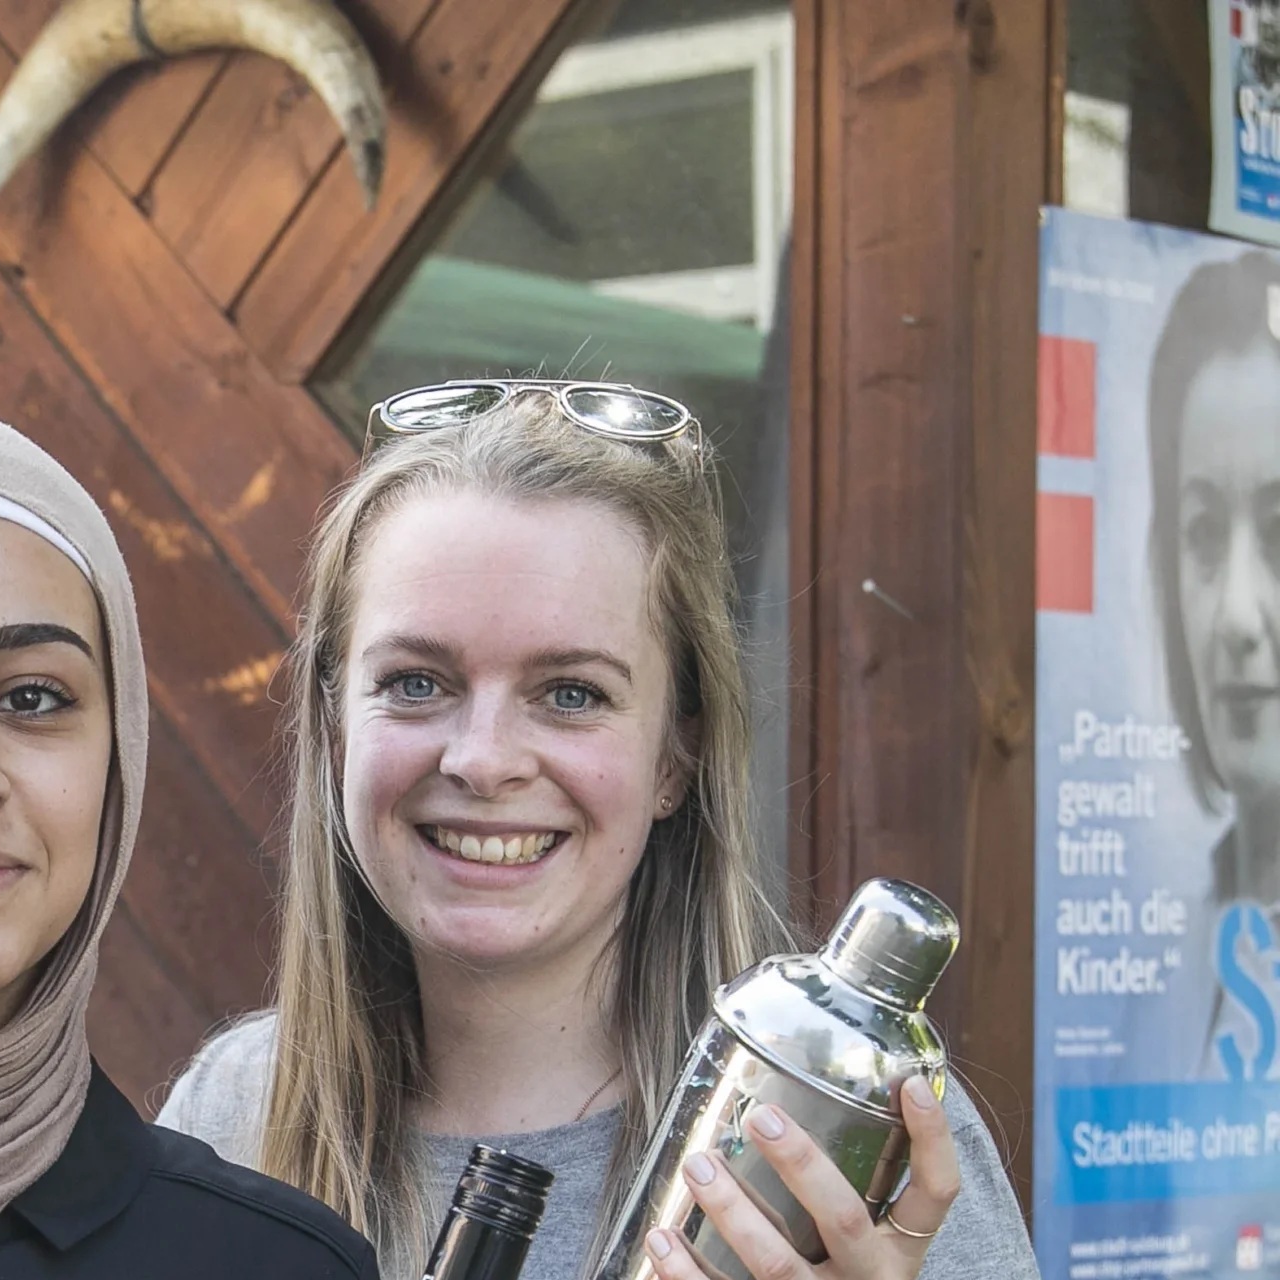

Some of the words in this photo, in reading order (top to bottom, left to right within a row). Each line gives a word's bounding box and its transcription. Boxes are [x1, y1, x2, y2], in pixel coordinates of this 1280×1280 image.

[1057, 772, 1156, 827] gewalt
[1057, 827, 1127, 877] trifft
[1057, 889, 1131, 935] auch
[1140, 888, 1187, 935] die
[1072, 1118, 1199, 1168] Stadtteile
[1202, 1115, 1260, 1160] ohne
